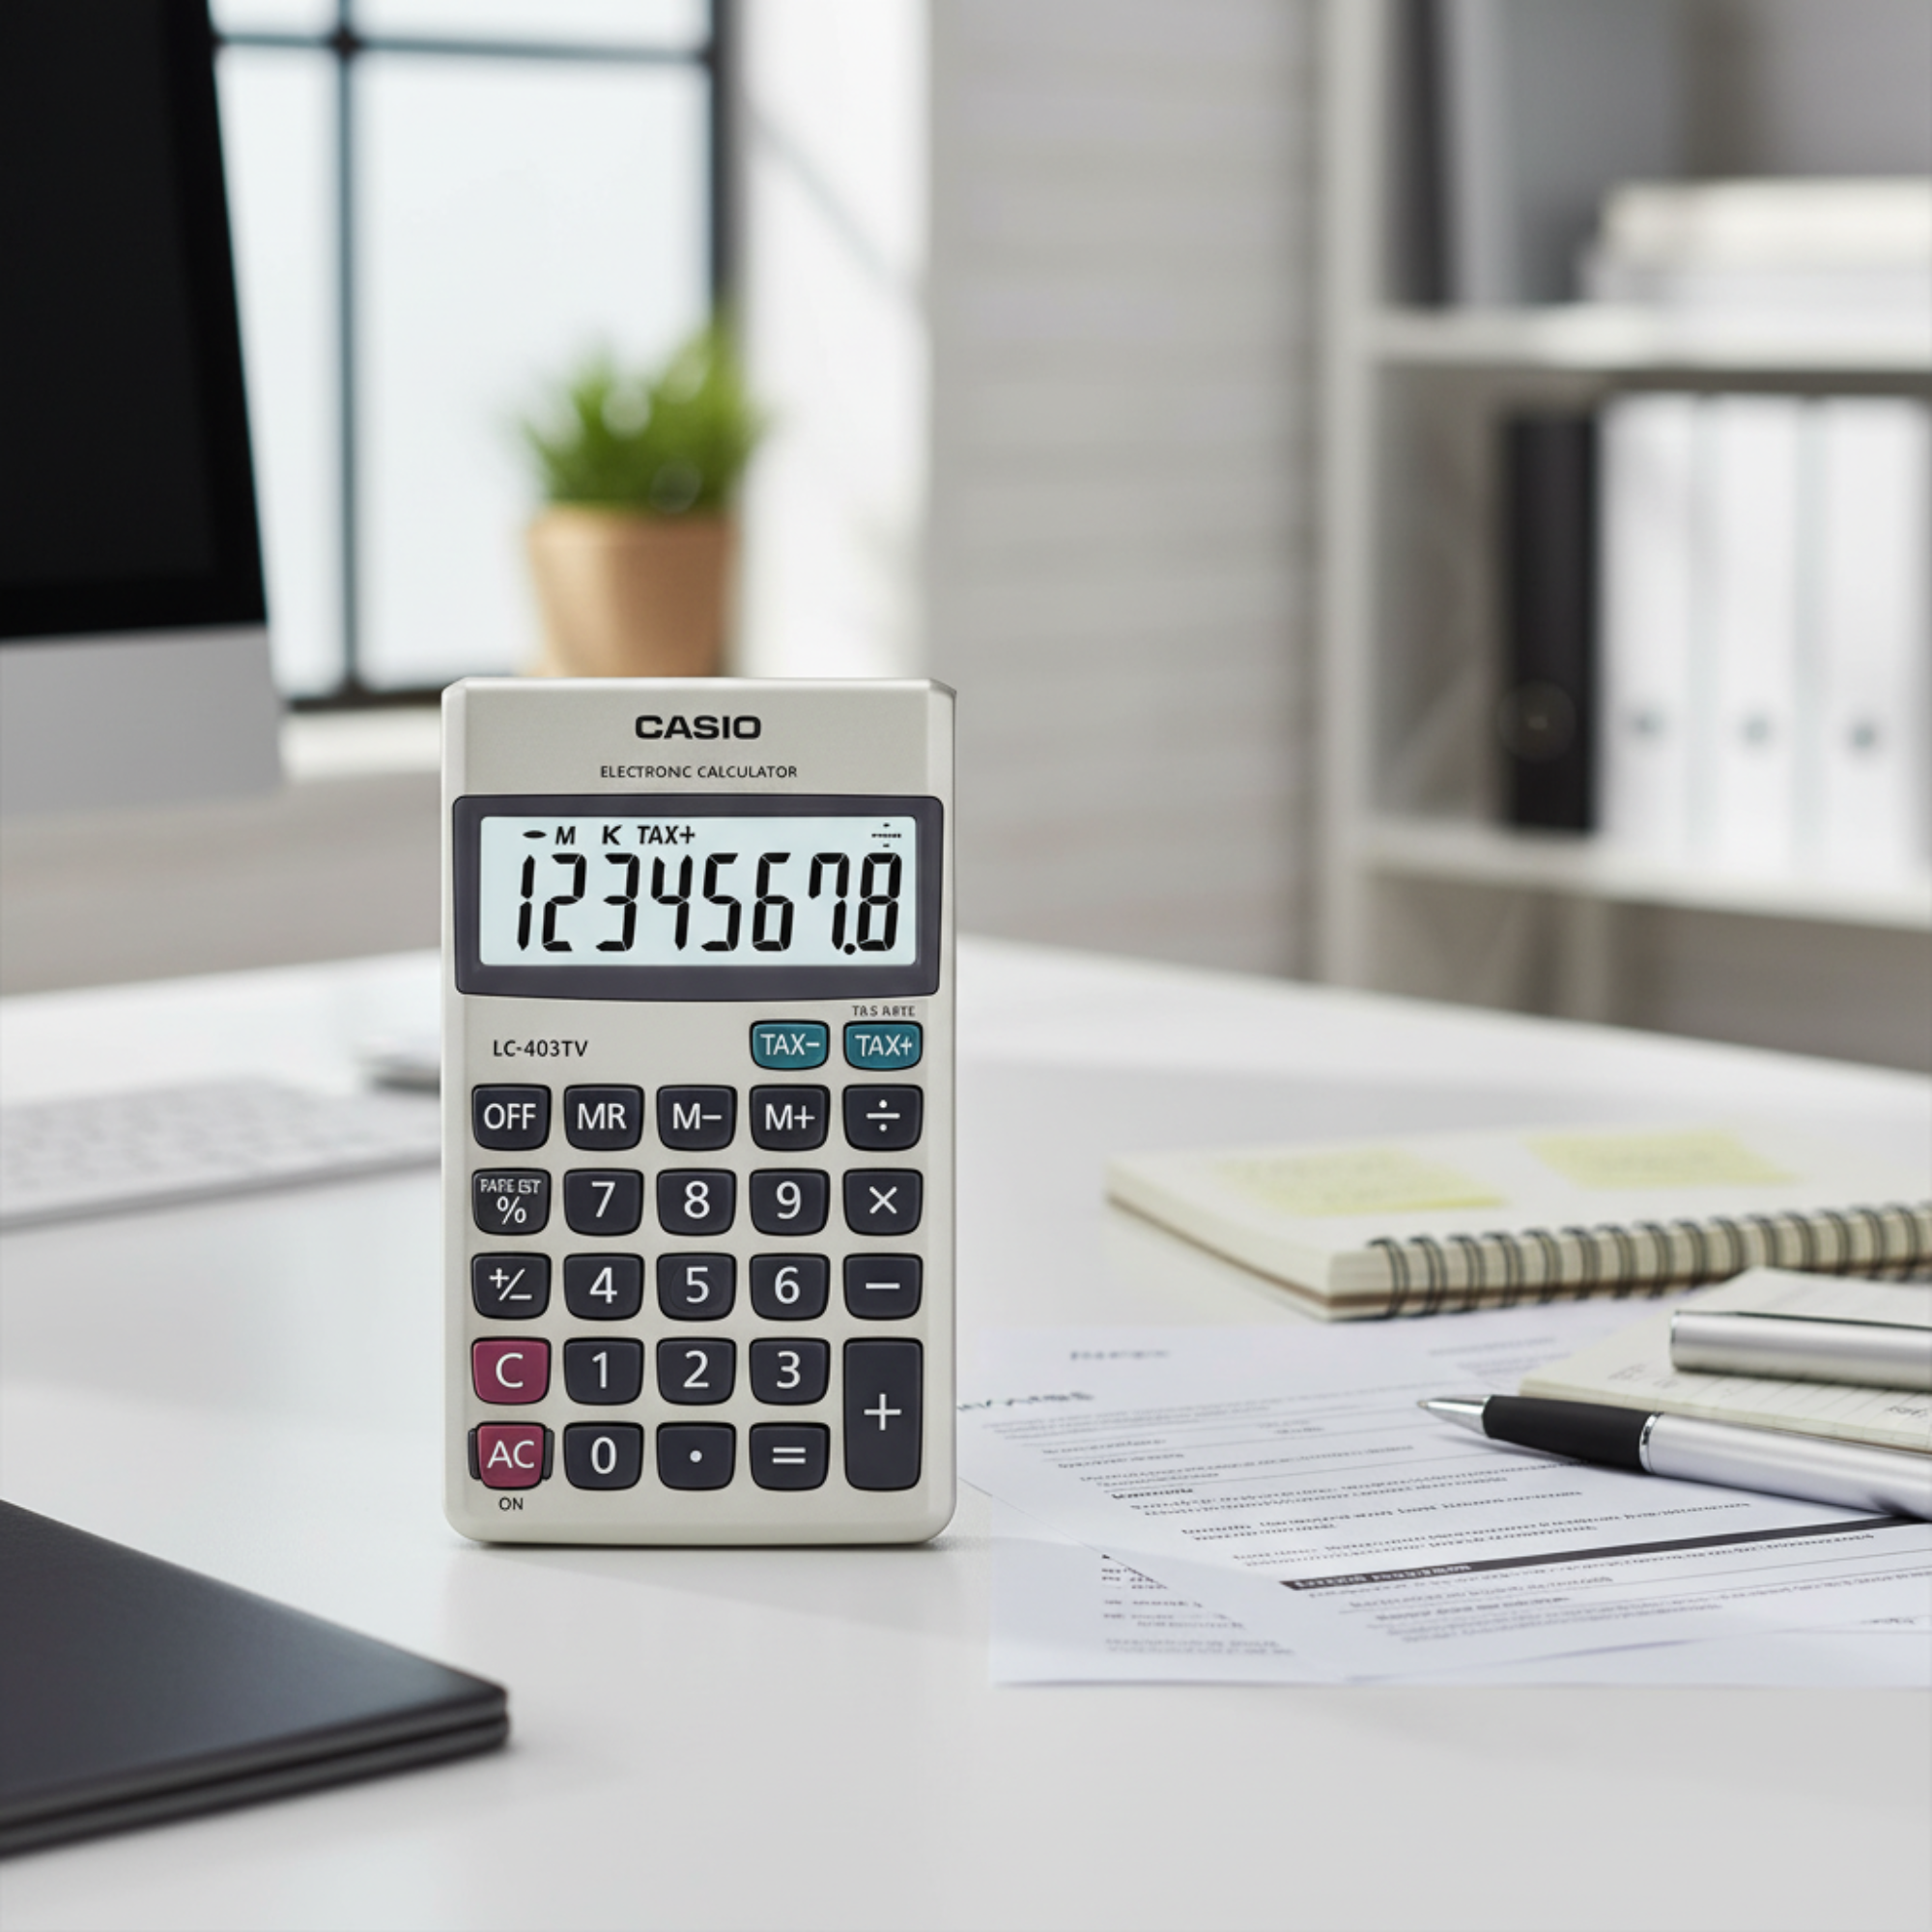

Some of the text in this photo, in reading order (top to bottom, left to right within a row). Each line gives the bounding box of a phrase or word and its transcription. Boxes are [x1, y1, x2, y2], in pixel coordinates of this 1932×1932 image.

[635, 715, 762, 740] CASIO
[696, 765, 798, 779] CALCULATOR
[554, 825, 696, 845] M K TAX+
[517, 852, 902, 952] 1234567.8
[493, 1038, 588, 1058] LC-403TV
[759, 1033, 820, 1056] TAX-
[854, 1034, 913, 1057] TAX+
[483, 1102, 536, 1130] OFF
[577, 1102, 627, 1130] MR
[672, 1102, 723, 1130] M-
[765, 1102, 815, 1131] M+
[496, 1195, 527, 1225] %
[591, 1180, 616, 1218] 7
[684, 1180, 710, 1219] 8
[776, 1180, 801, 1220] 9
[589, 1266, 618, 1304] 4
[686, 1266, 709, 1304] 5
[775, 1265, 800, 1304] 6
[495, 1352, 524, 1389] C
[591, 1351, 608, 1388] 1
[684, 1350, 709, 1388] 2
[776, 1350, 801, 1389] 3
[487, 1439, 535, 1470] AC
[591, 1436, 617, 1474] 0
[498, 1496, 524, 1512] ON
